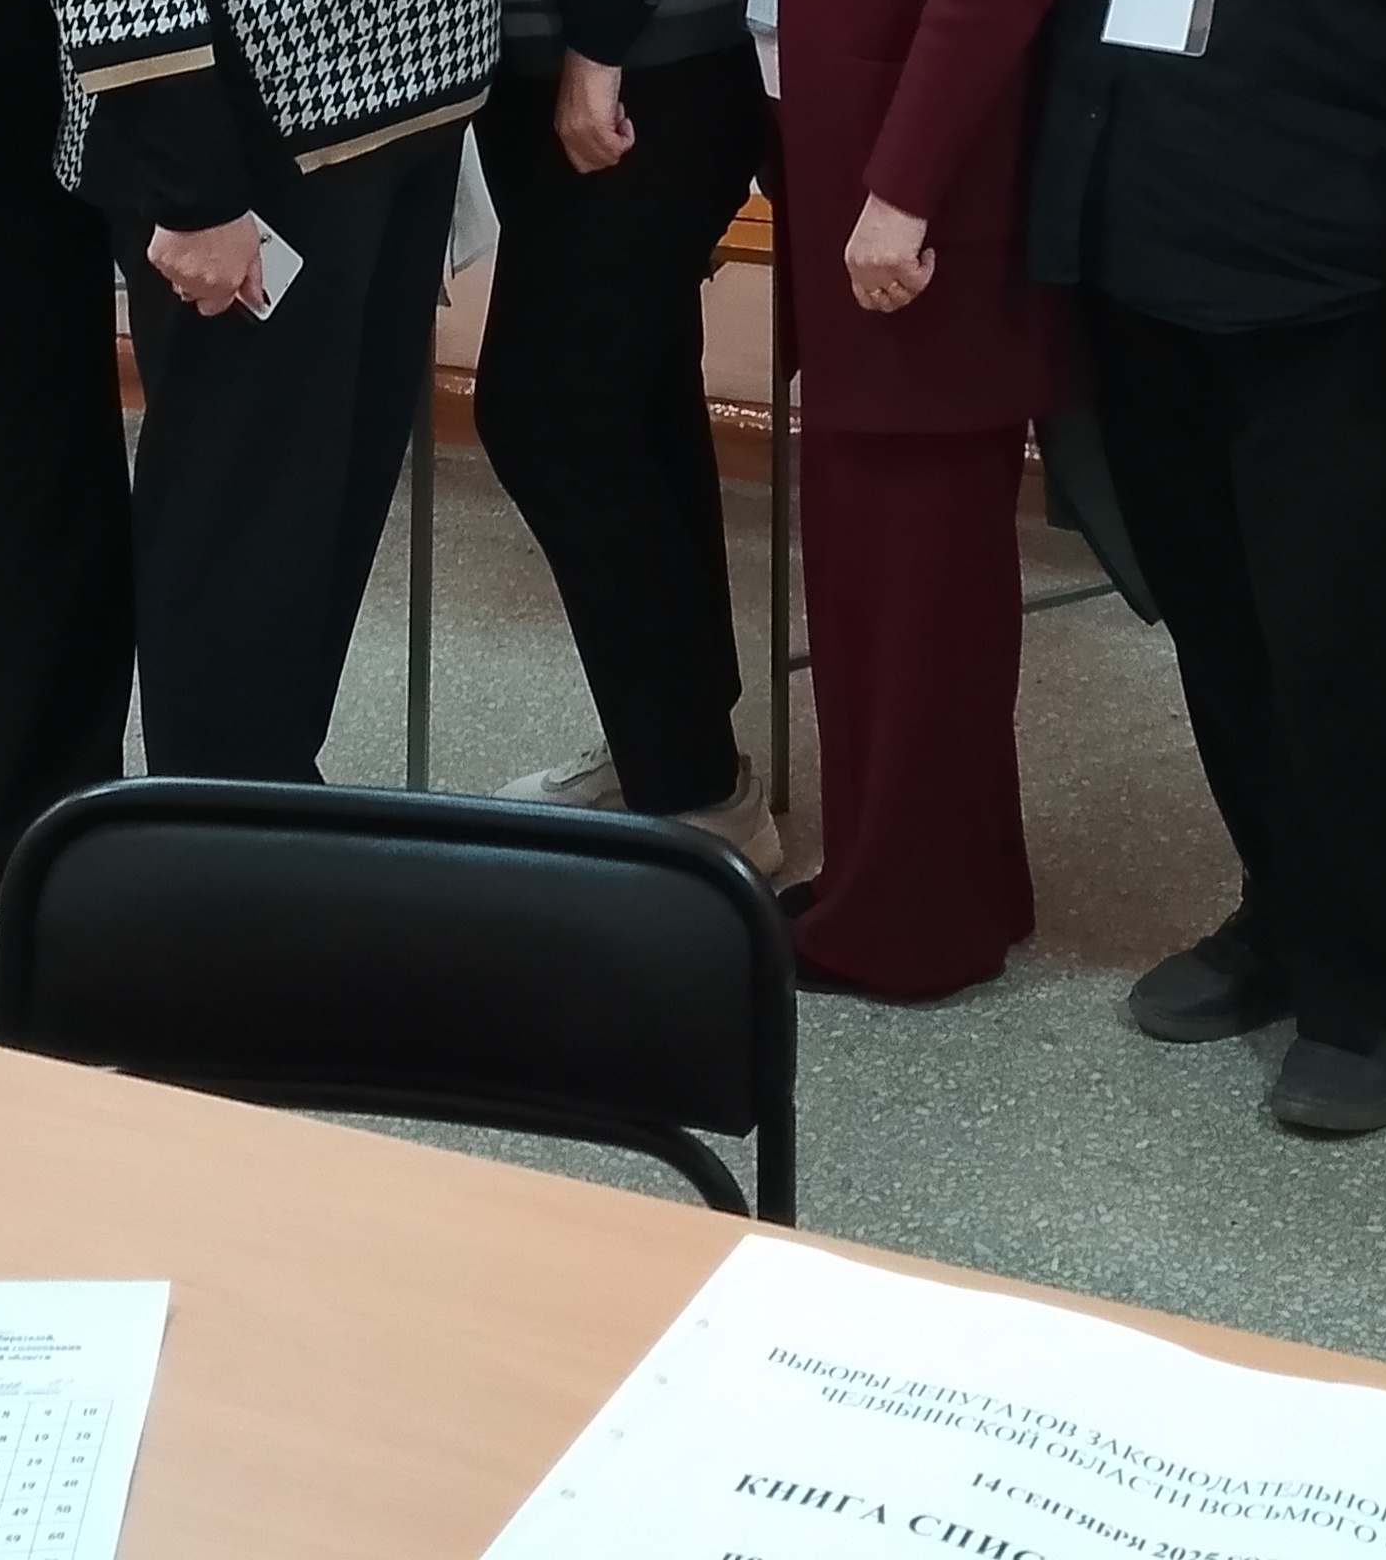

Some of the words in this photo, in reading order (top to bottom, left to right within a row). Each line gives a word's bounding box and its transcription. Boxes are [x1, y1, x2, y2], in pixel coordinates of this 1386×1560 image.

[768, 1346, 892, 1391] ВЫБОРЫ
[893, 1378, 1078, 1438] ДЕПУТАТОВ
[734, 1473, 887, 1525] КНИГА
[821, 1386, 1040, 1450] ЧЕЛЯБИНСКОЙ
[1046, 1442, 1191, 1509] ОБЛАСТИ
[1199, 1497, 1377, 1544] ВОСЬМОГО
[972, 1472, 1002, 1493] 14
[1006, 1486, 1147, 1552] СЕНТЯБРЯ
